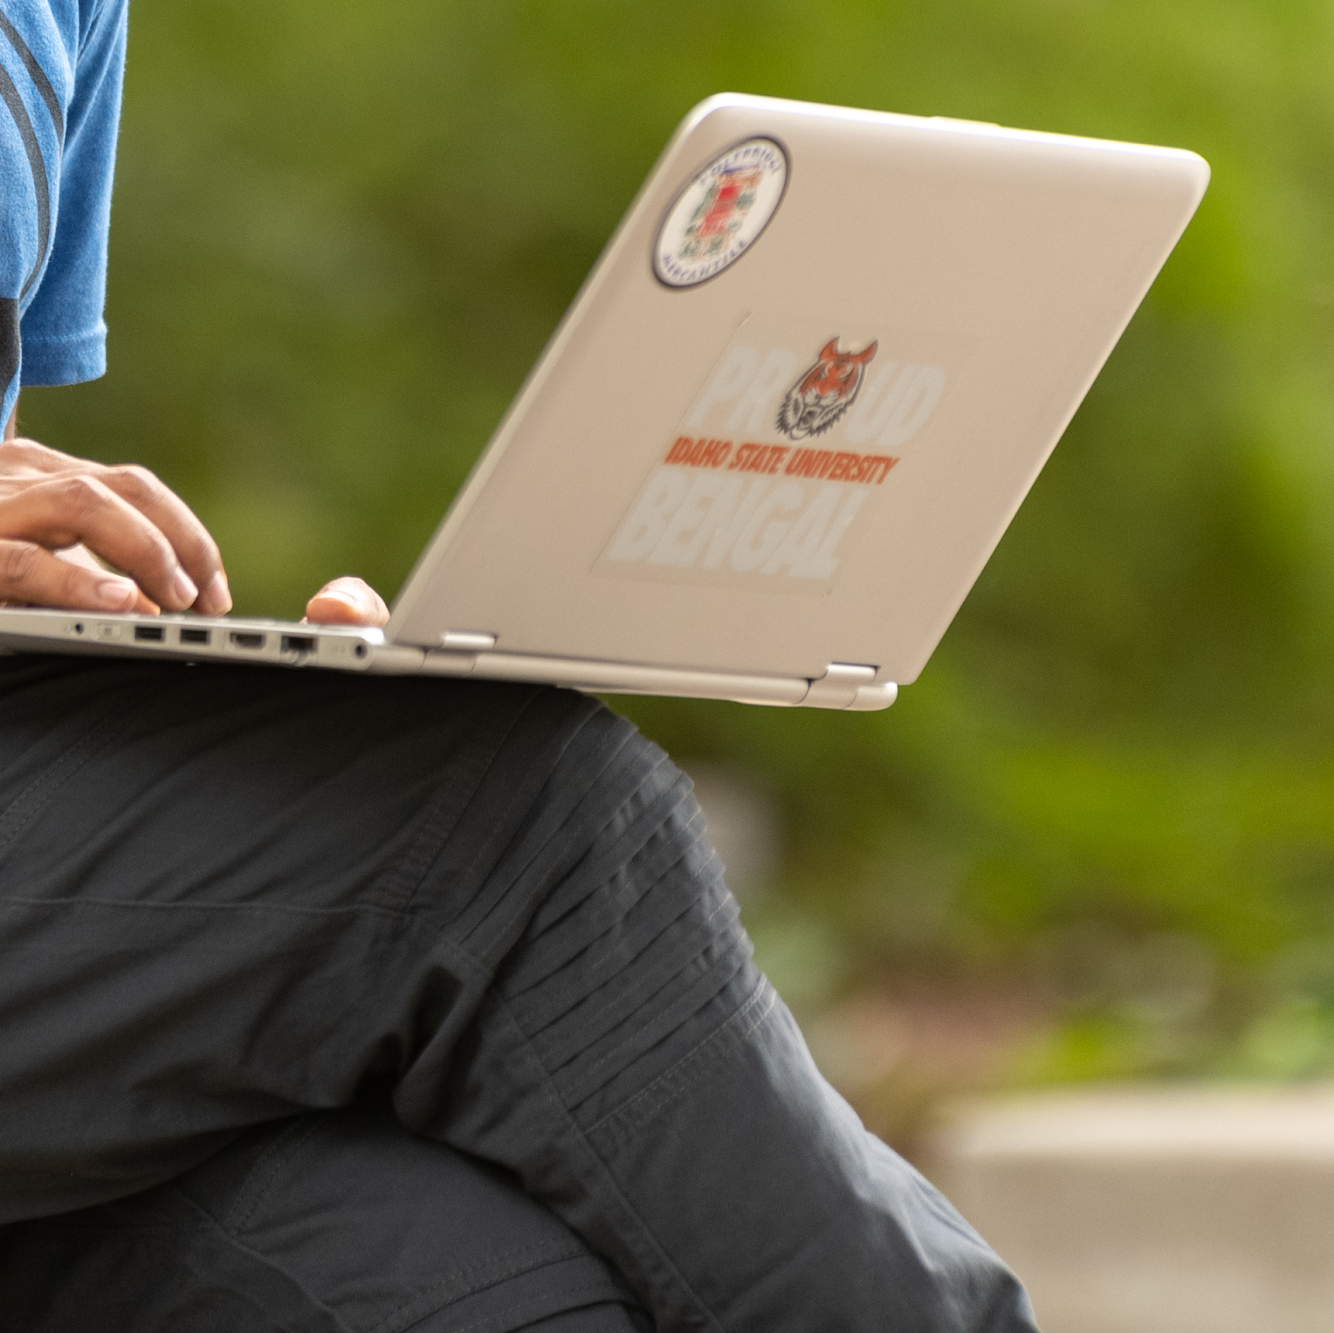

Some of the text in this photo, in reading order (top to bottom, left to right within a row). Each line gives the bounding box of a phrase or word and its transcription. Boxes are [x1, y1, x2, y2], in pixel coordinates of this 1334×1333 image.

[664, 435, 901, 485] IDAHO STATE UNIVERSITY
[606, 469, 869, 580] BENGAL
